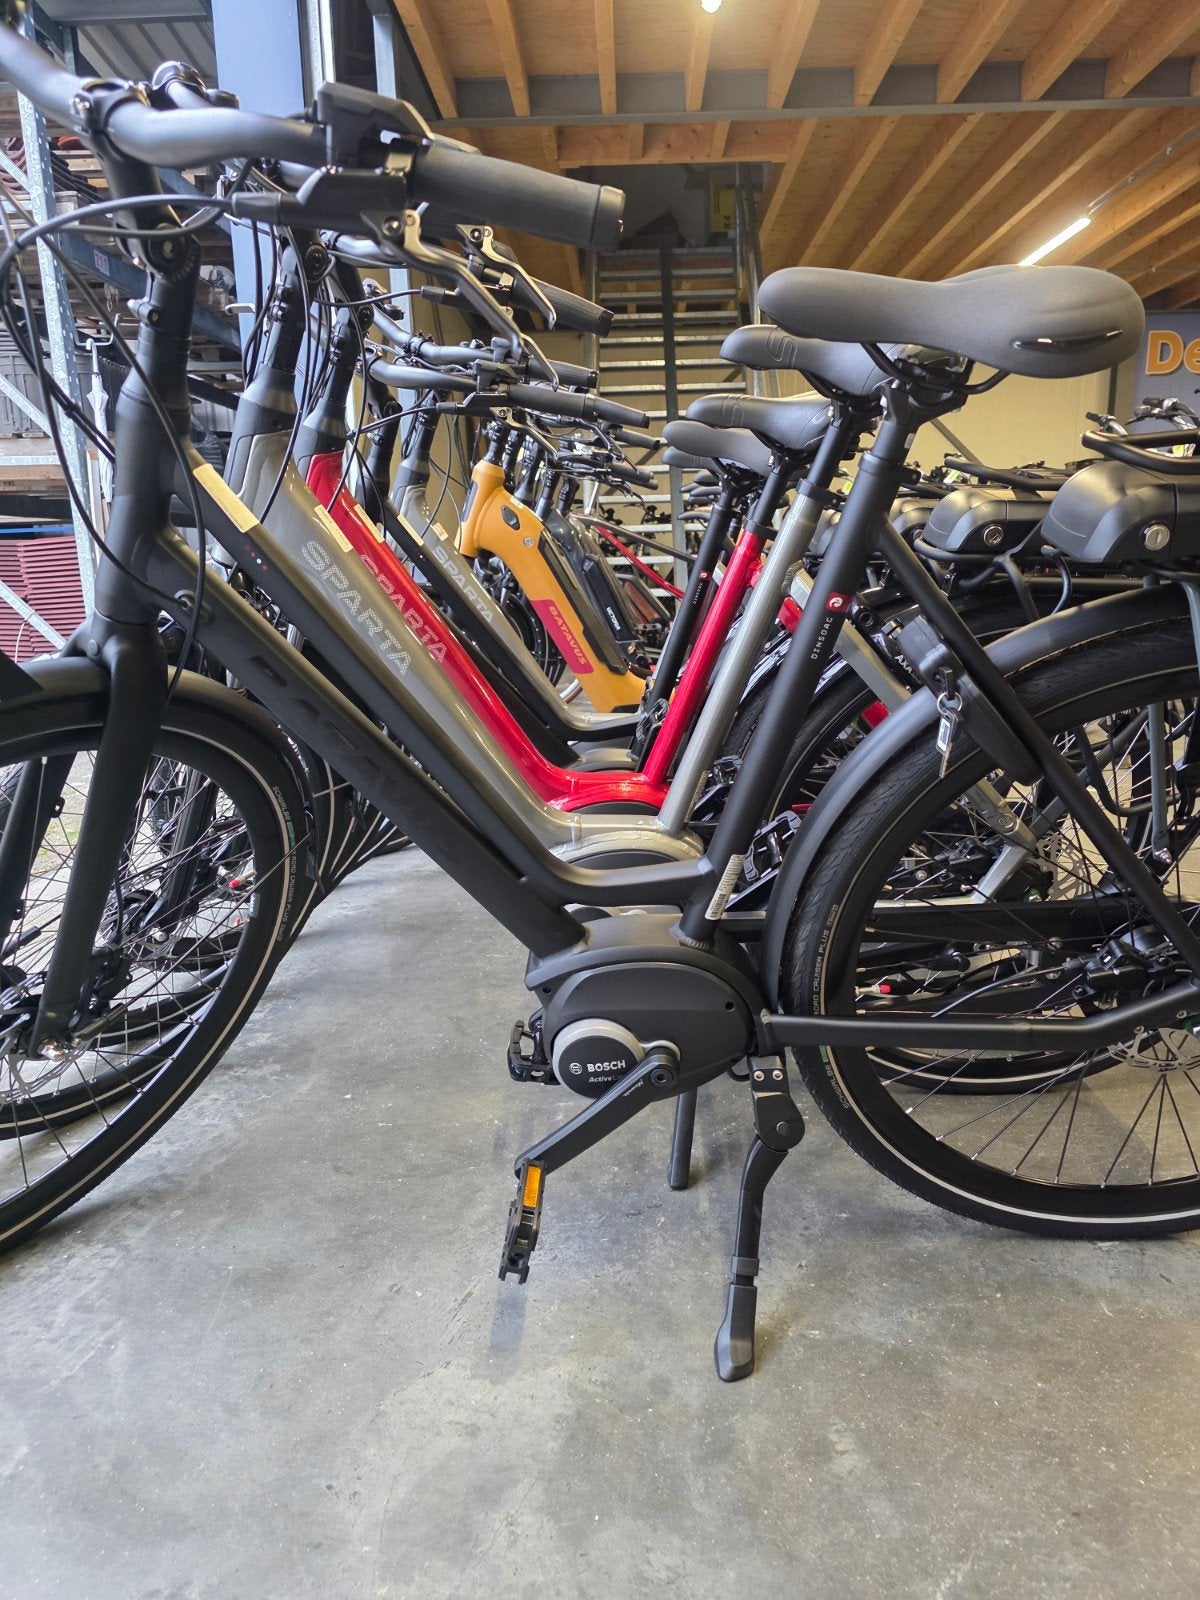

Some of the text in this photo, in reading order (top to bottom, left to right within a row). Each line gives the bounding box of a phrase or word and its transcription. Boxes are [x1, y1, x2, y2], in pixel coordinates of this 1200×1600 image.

[301, 540, 412, 676] SPARTA
[432, 545, 493, 623] SPARTA
[548, 605, 587, 665] BATAVUS
[810, 616, 834, 660] DINSDAG
[894, 654, 913, 674] AXA
[813, 956, 823, 992] CRUISER
[818, 929, 831, 954] PLUS
[586, 1059, 626, 1073] BOSCH
[824, 1064, 851, 1109] SCHWALBE
